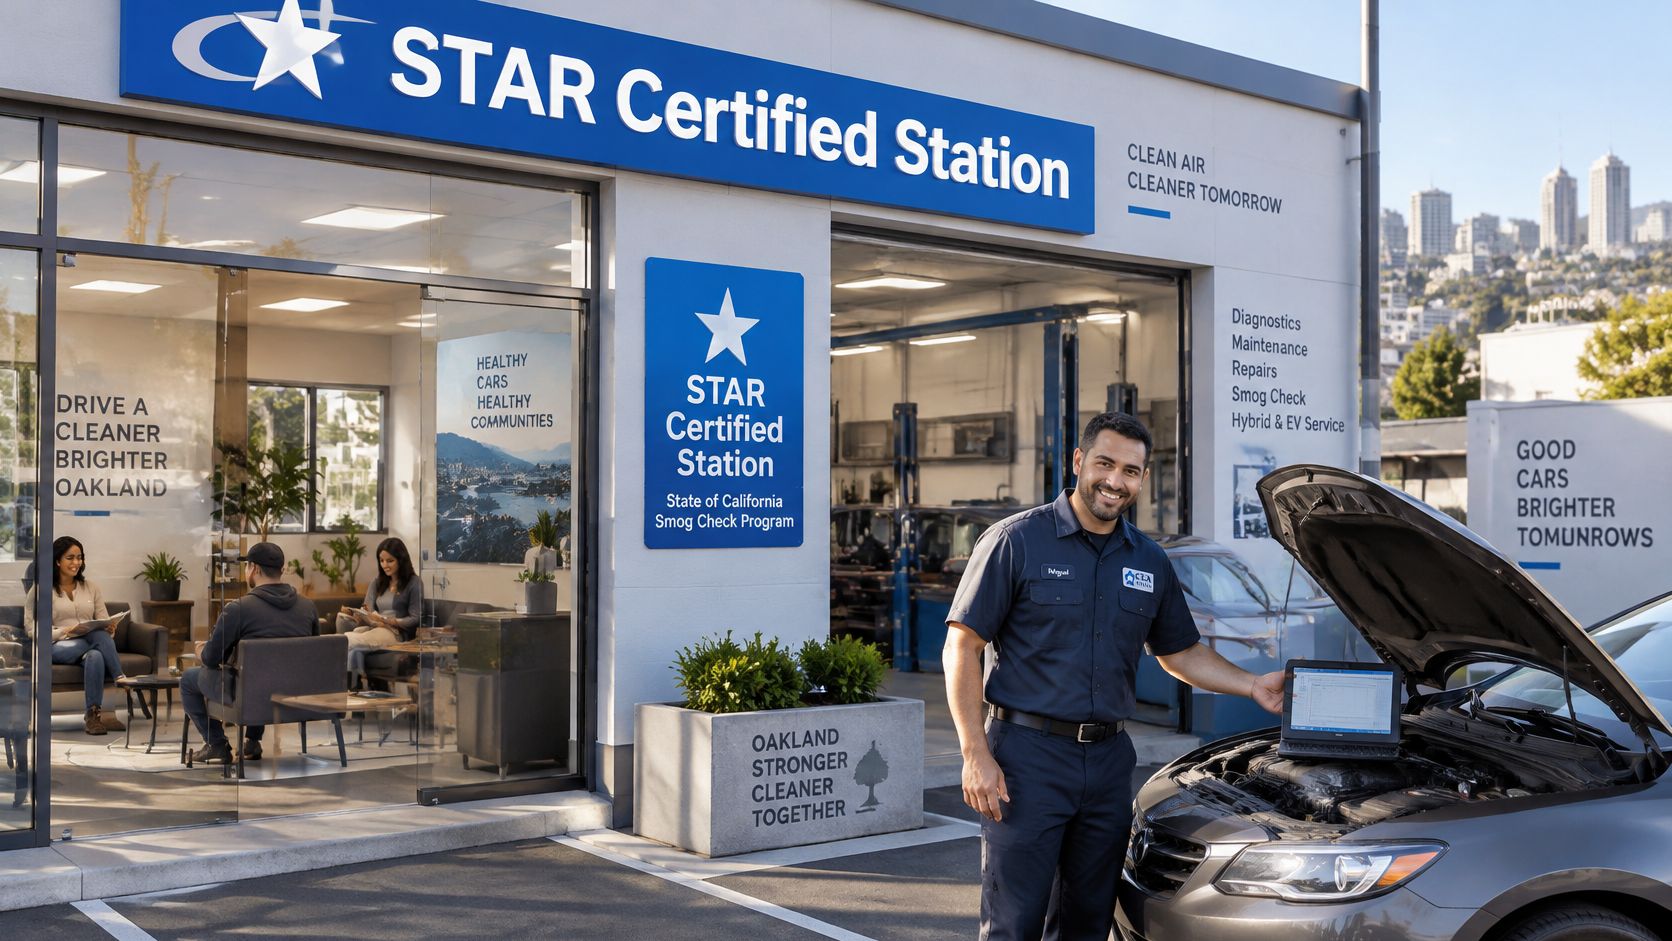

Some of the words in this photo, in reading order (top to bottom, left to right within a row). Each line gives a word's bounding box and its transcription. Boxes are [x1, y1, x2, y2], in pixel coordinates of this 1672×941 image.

[391, 26, 596, 124] STAR
[616, 68, 877, 168] Certified
[895, 119, 1069, 199] Station
[1127, 143, 1177, 169] CLEAN
[1181, 154, 1205, 174] AIR
[1127, 171, 1196, 200] CLEANER
[1200, 184, 1282, 214] TOMORROW
[1232, 308, 1301, 331] Diagnostics
[1232, 334, 1308, 357] Maintenance
[477, 353, 528, 371] HEALTHY
[1232, 360, 1278, 380] Repairs
[477, 375, 508, 389] CARS
[686, 374, 766, 407] STAR
[57, 394, 125, 415] DRIVE
[133, 398, 149, 415] A
[477, 394, 532, 409] HEALTHY
[1232, 386, 1267, 407] Smog
[1270, 388, 1306, 406] Check
[55, 421, 160, 443] CLEANER
[471, 414, 554, 429] COMMUNITIES
[665, 411, 783, 443] Certified
[1232, 412, 1271, 433] Hybrid
[1274, 414, 1283, 430] &
[1286, 415, 1302, 431] EV
[1304, 416, 1345, 432] Service
[55, 449, 168, 470] BRIGHTER
[1516, 439, 1576, 460] GOOD
[677, 448, 774, 477] Station
[55, 478, 168, 497] OAKLAND
[1516, 468, 1569, 489] CARS
[666, 493, 701, 508] State
[705, 494, 719, 508] of
[722, 493, 783, 508] California
[1517, 497, 1616, 518] BRIGHTER
[655, 514, 693, 532] Smog
[697, 513, 738, 528] Check
[741, 514, 794, 532] Program
[752, 728, 840, 752] OAKLAND
[752, 751, 849, 778] STRONGER
[752, 777, 834, 803] CLEANER
[752, 799, 846, 828] TOGETHER
